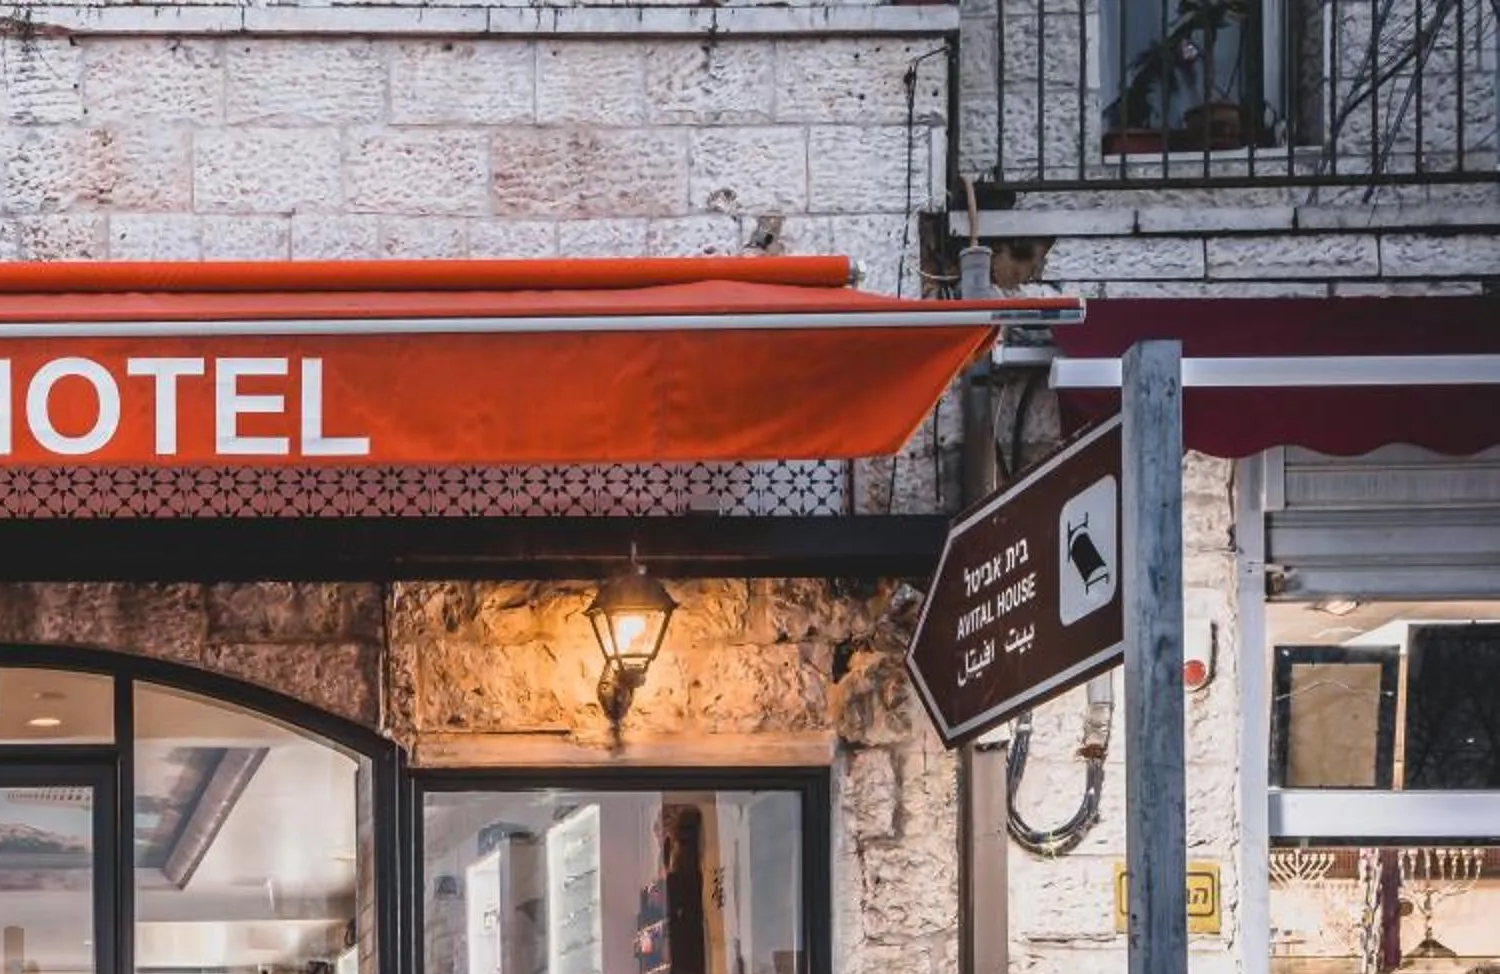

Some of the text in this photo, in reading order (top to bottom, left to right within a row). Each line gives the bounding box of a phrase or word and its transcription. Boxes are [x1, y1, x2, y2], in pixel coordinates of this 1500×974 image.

[963, 537, 1030, 598] בית אביטל
[956, 572, 1037, 641] AVITAL HOUSE
[1004, 623, 1036, 654] بيت
